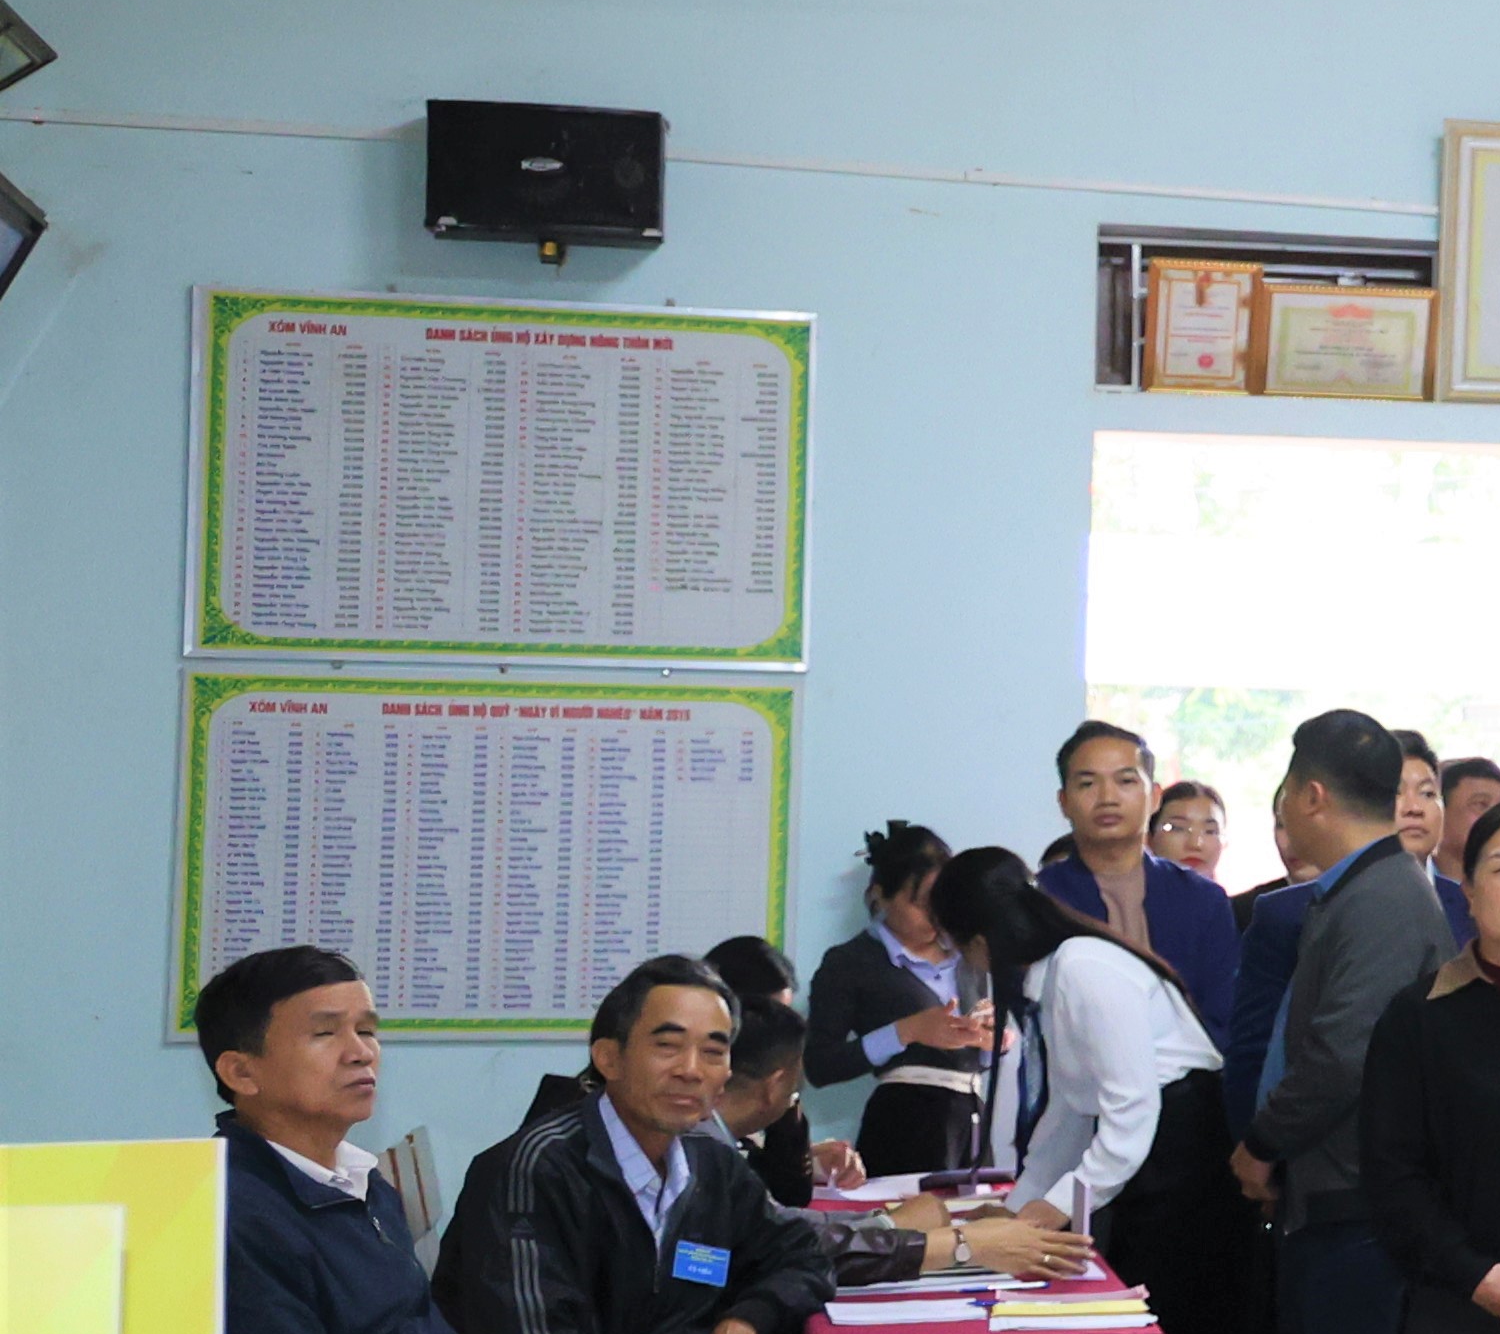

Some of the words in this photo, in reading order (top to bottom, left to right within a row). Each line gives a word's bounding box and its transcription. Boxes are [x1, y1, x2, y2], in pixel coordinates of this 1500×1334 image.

[268, 320, 296, 334] XÓM
[299, 319, 327, 336] VĨNH
[329, 324, 348, 336] AN
[425, 327, 456, 341] DANH
[249, 699, 276, 713] XÓM
[280, 699, 308, 714] VĨNH
[310, 702, 328, 715] AN
[381, 702, 411, 716] DANH
